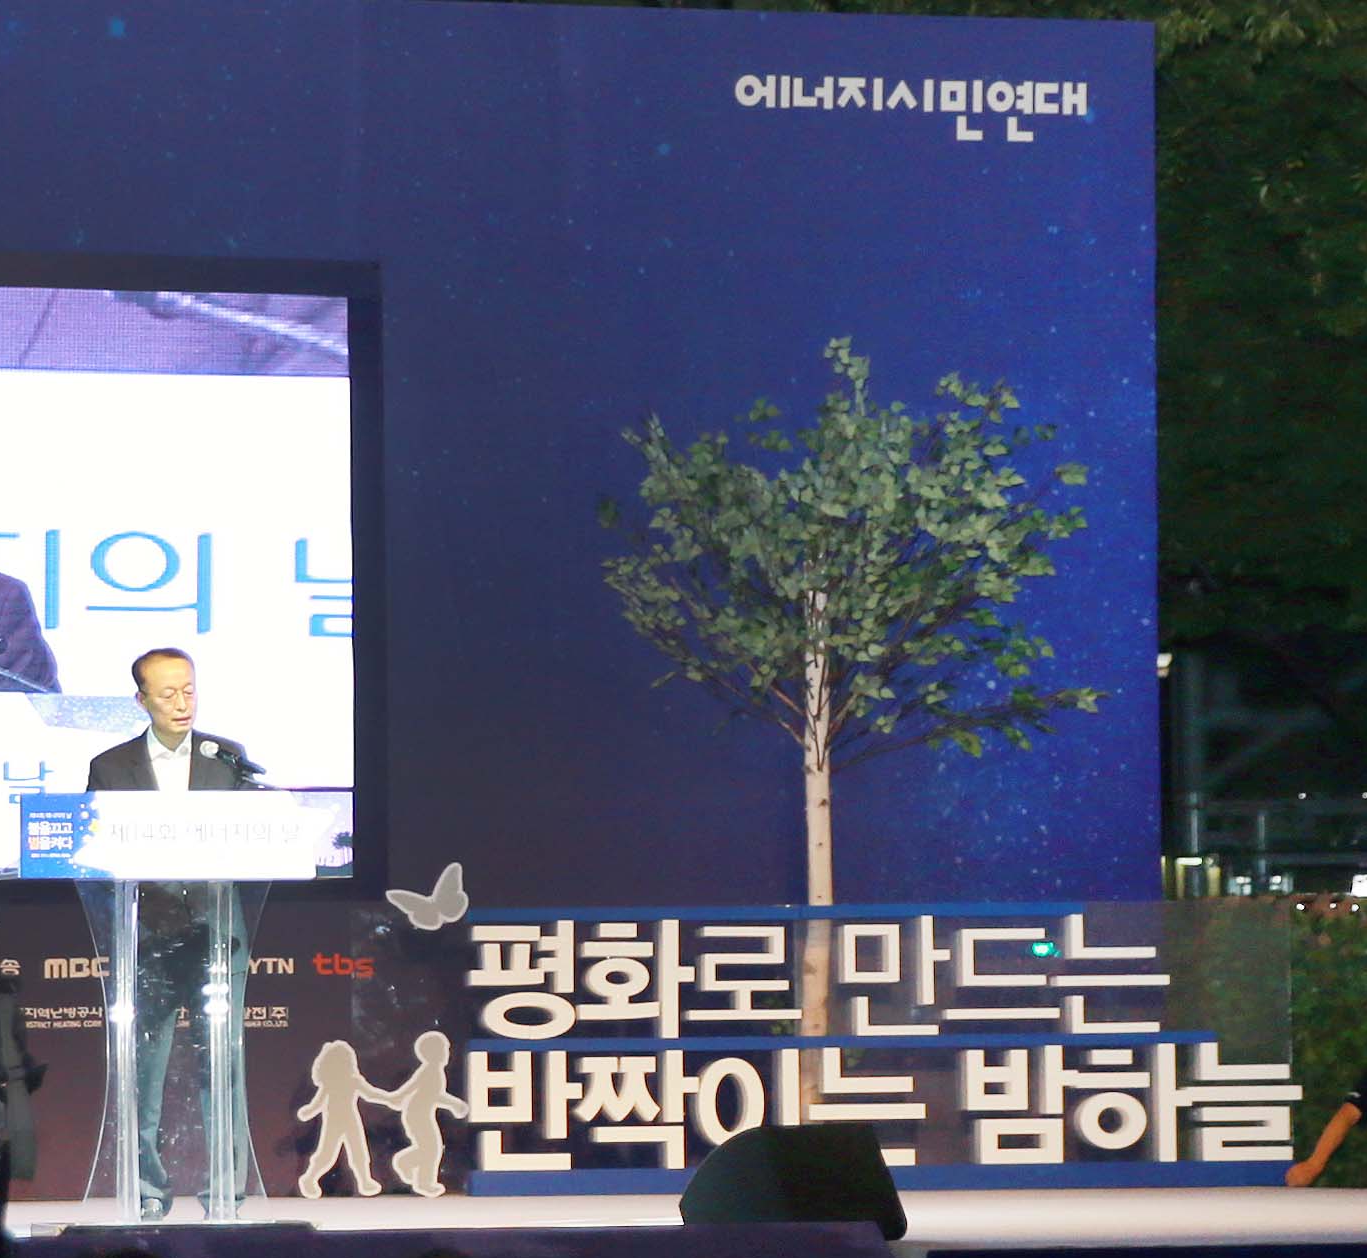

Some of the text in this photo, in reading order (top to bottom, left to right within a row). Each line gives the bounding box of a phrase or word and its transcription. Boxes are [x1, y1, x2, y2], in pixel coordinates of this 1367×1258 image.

[734, 73, 1088, 142] 에너지시민연대
[44, 956, 110, 979] MBC
[248, 957, 295, 974] YTN
[313, 953, 375, 978] tbs
[469, 913, 1170, 1040] 평화로 만드는
[20, 1007, 103, 1019] 지역난방공사
[467, 1042, 1303, 1172] 반짝이는 밤하늘
